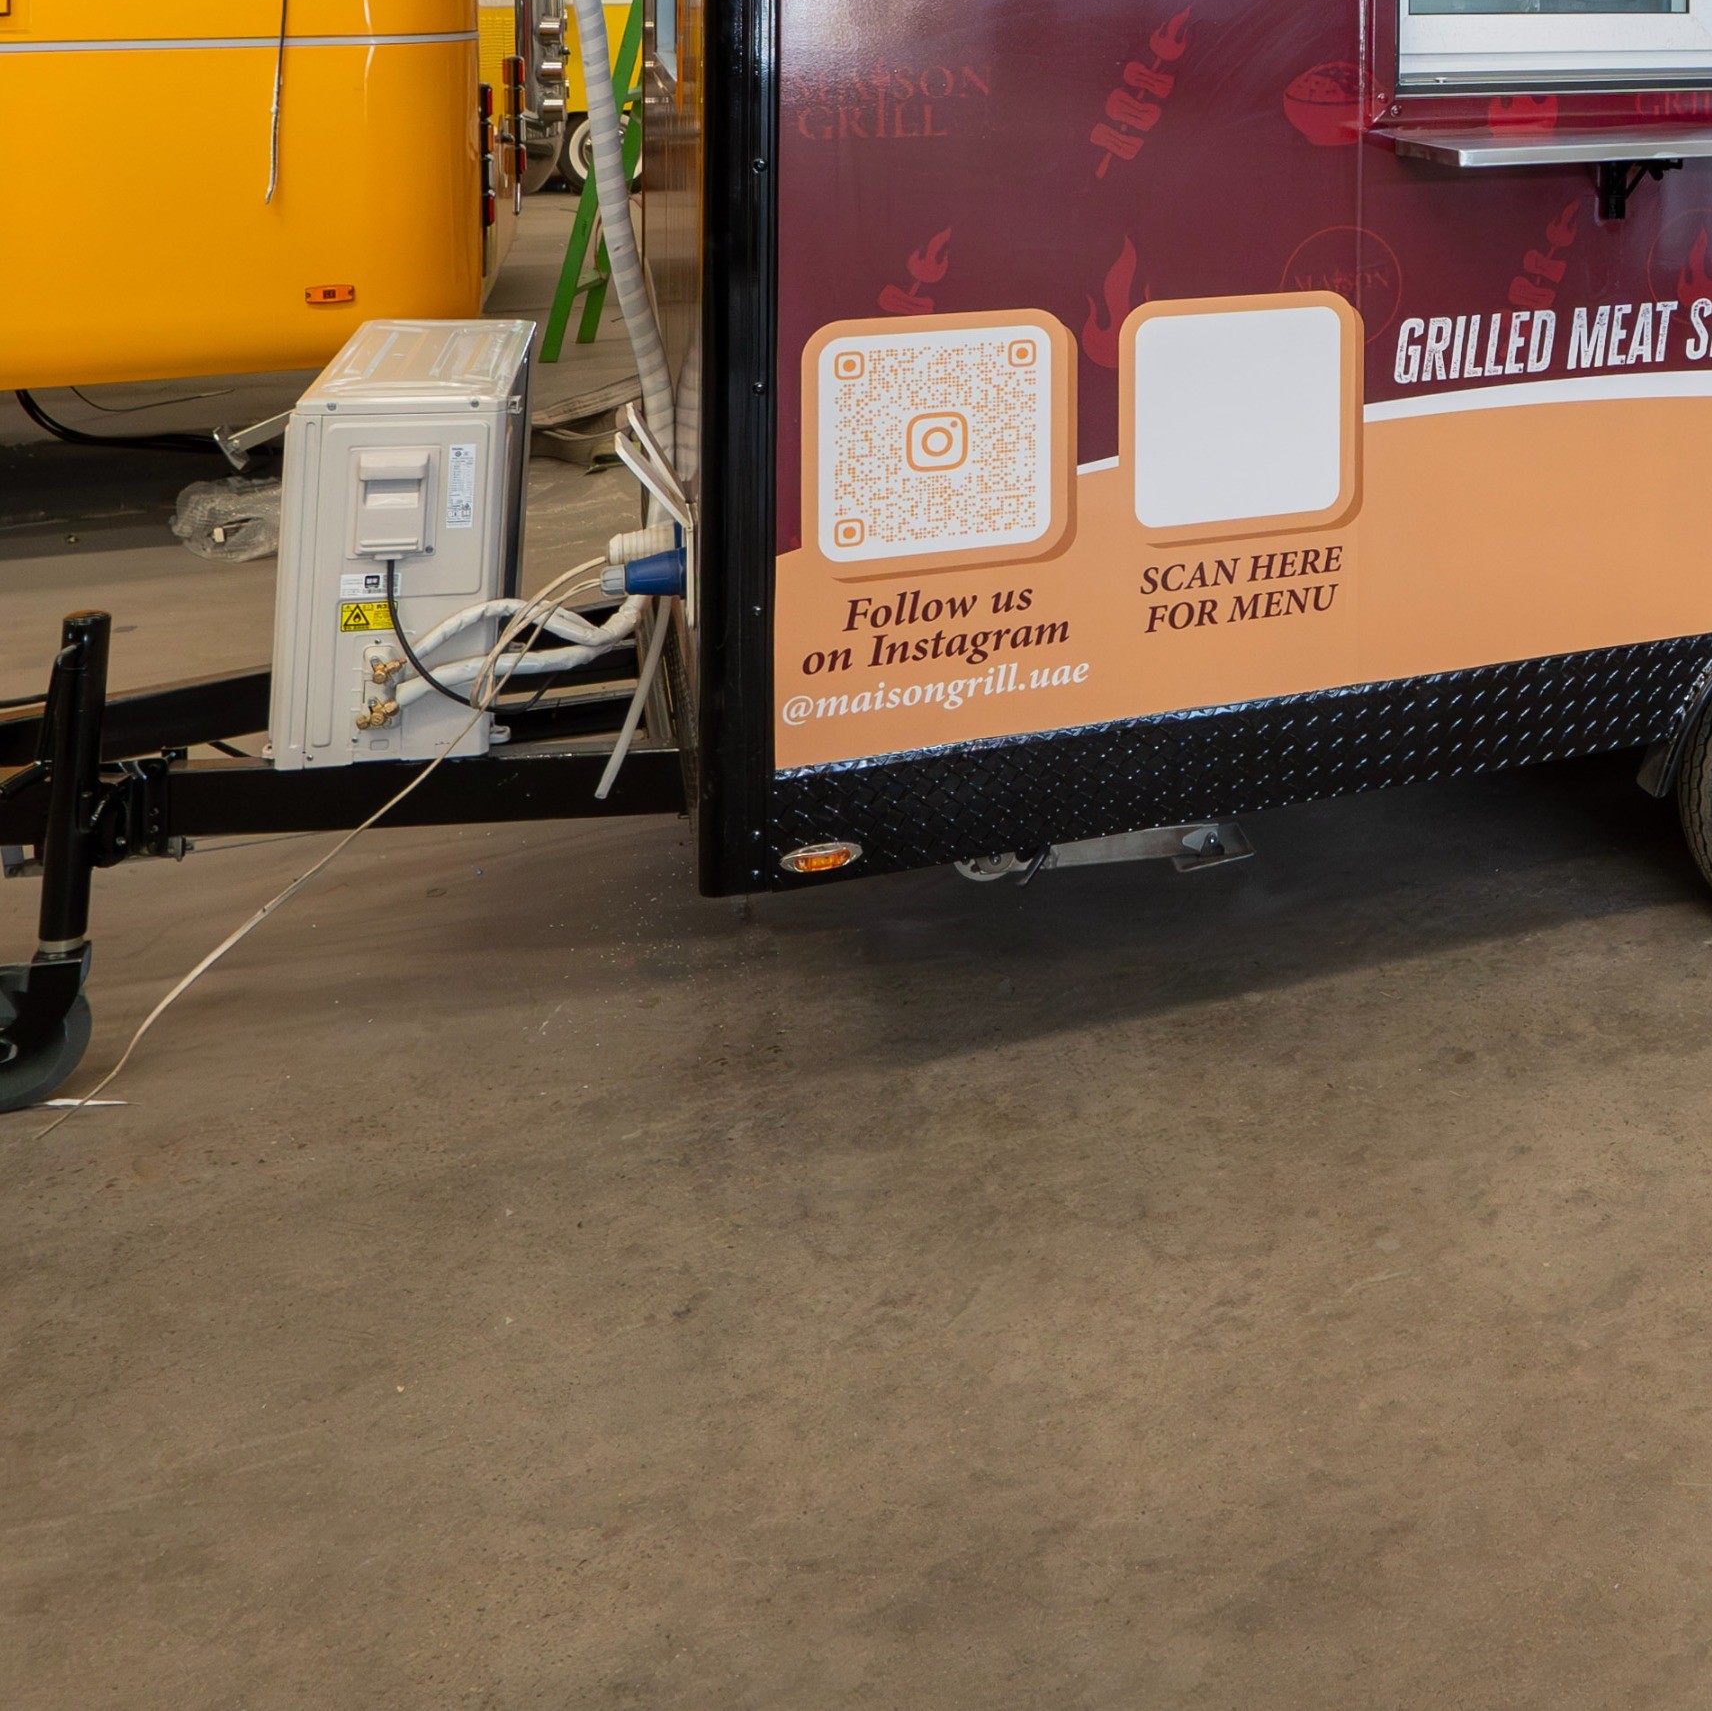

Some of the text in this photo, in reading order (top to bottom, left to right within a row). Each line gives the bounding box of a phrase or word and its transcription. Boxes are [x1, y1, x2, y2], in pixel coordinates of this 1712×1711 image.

[797, 98, 949, 140] GRILL
[1394, 309, 1555, 384] GRILLED
[1567, 299, 1679, 369] MEAT
[1139, 546, 1343, 594] SCAN HERE
[844, 587, 1033, 632] Follow us
[1144, 584, 1337, 633] FOR MENU
[803, 621, 1070, 675] on Instagram
[782, 661, 1089, 727] @maisongrill.uae
